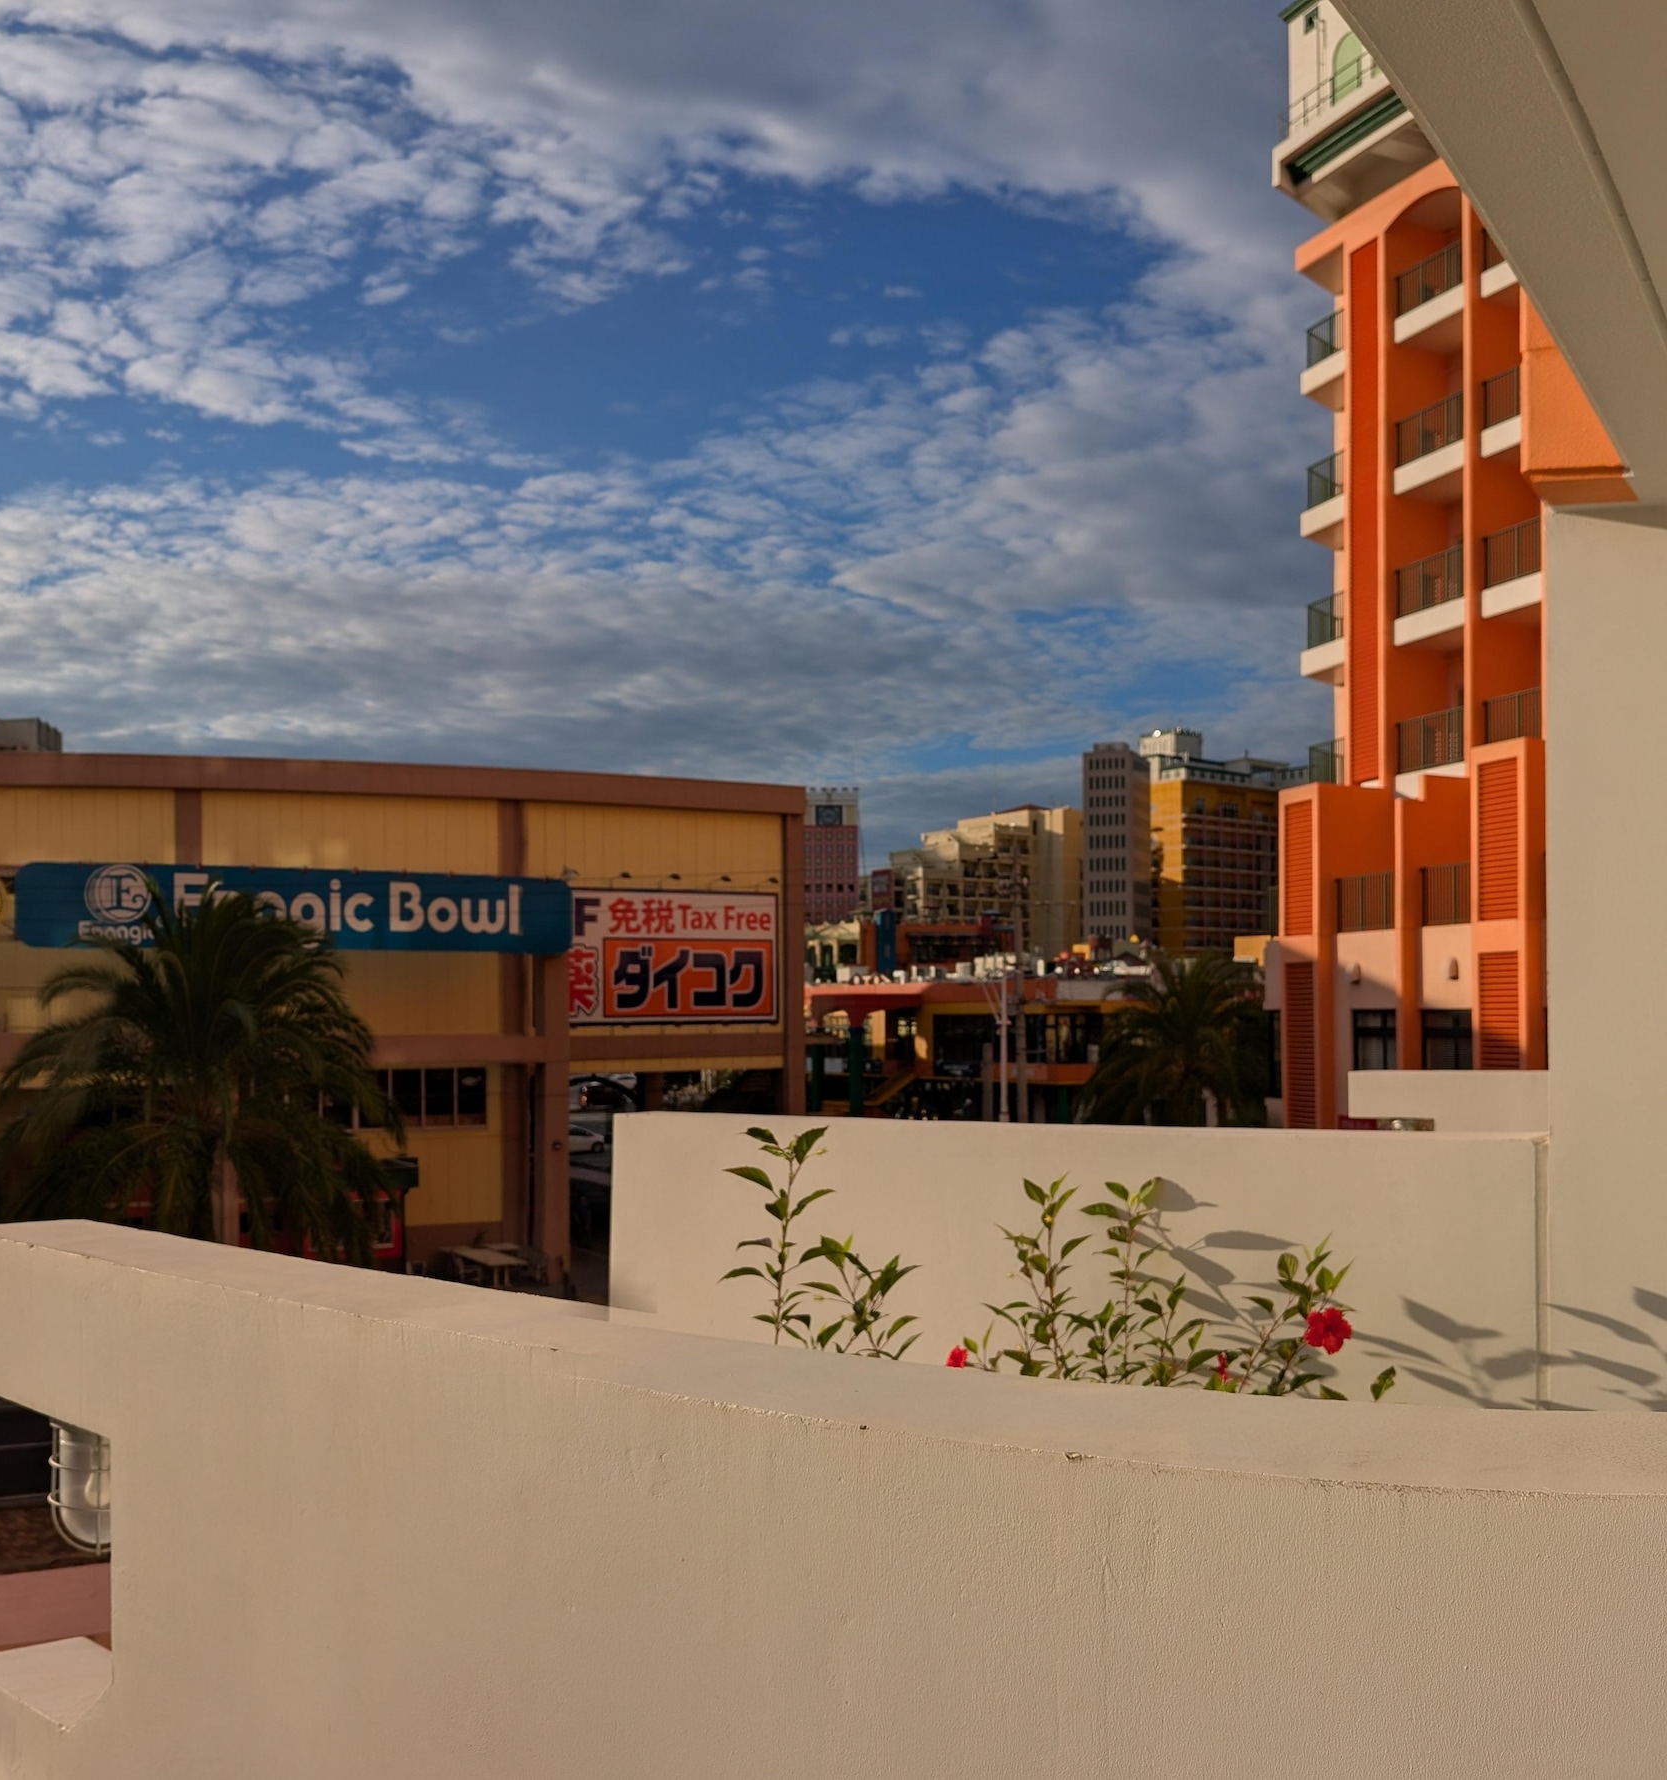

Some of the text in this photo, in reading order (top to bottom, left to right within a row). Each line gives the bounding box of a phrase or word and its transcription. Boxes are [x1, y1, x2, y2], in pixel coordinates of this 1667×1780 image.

[389, 881, 523, 936] Bowl
[608, 898, 676, 935] 免税
[678, 904, 771, 931] Tax Free
[614, 946, 763, 1009] ダイコク
